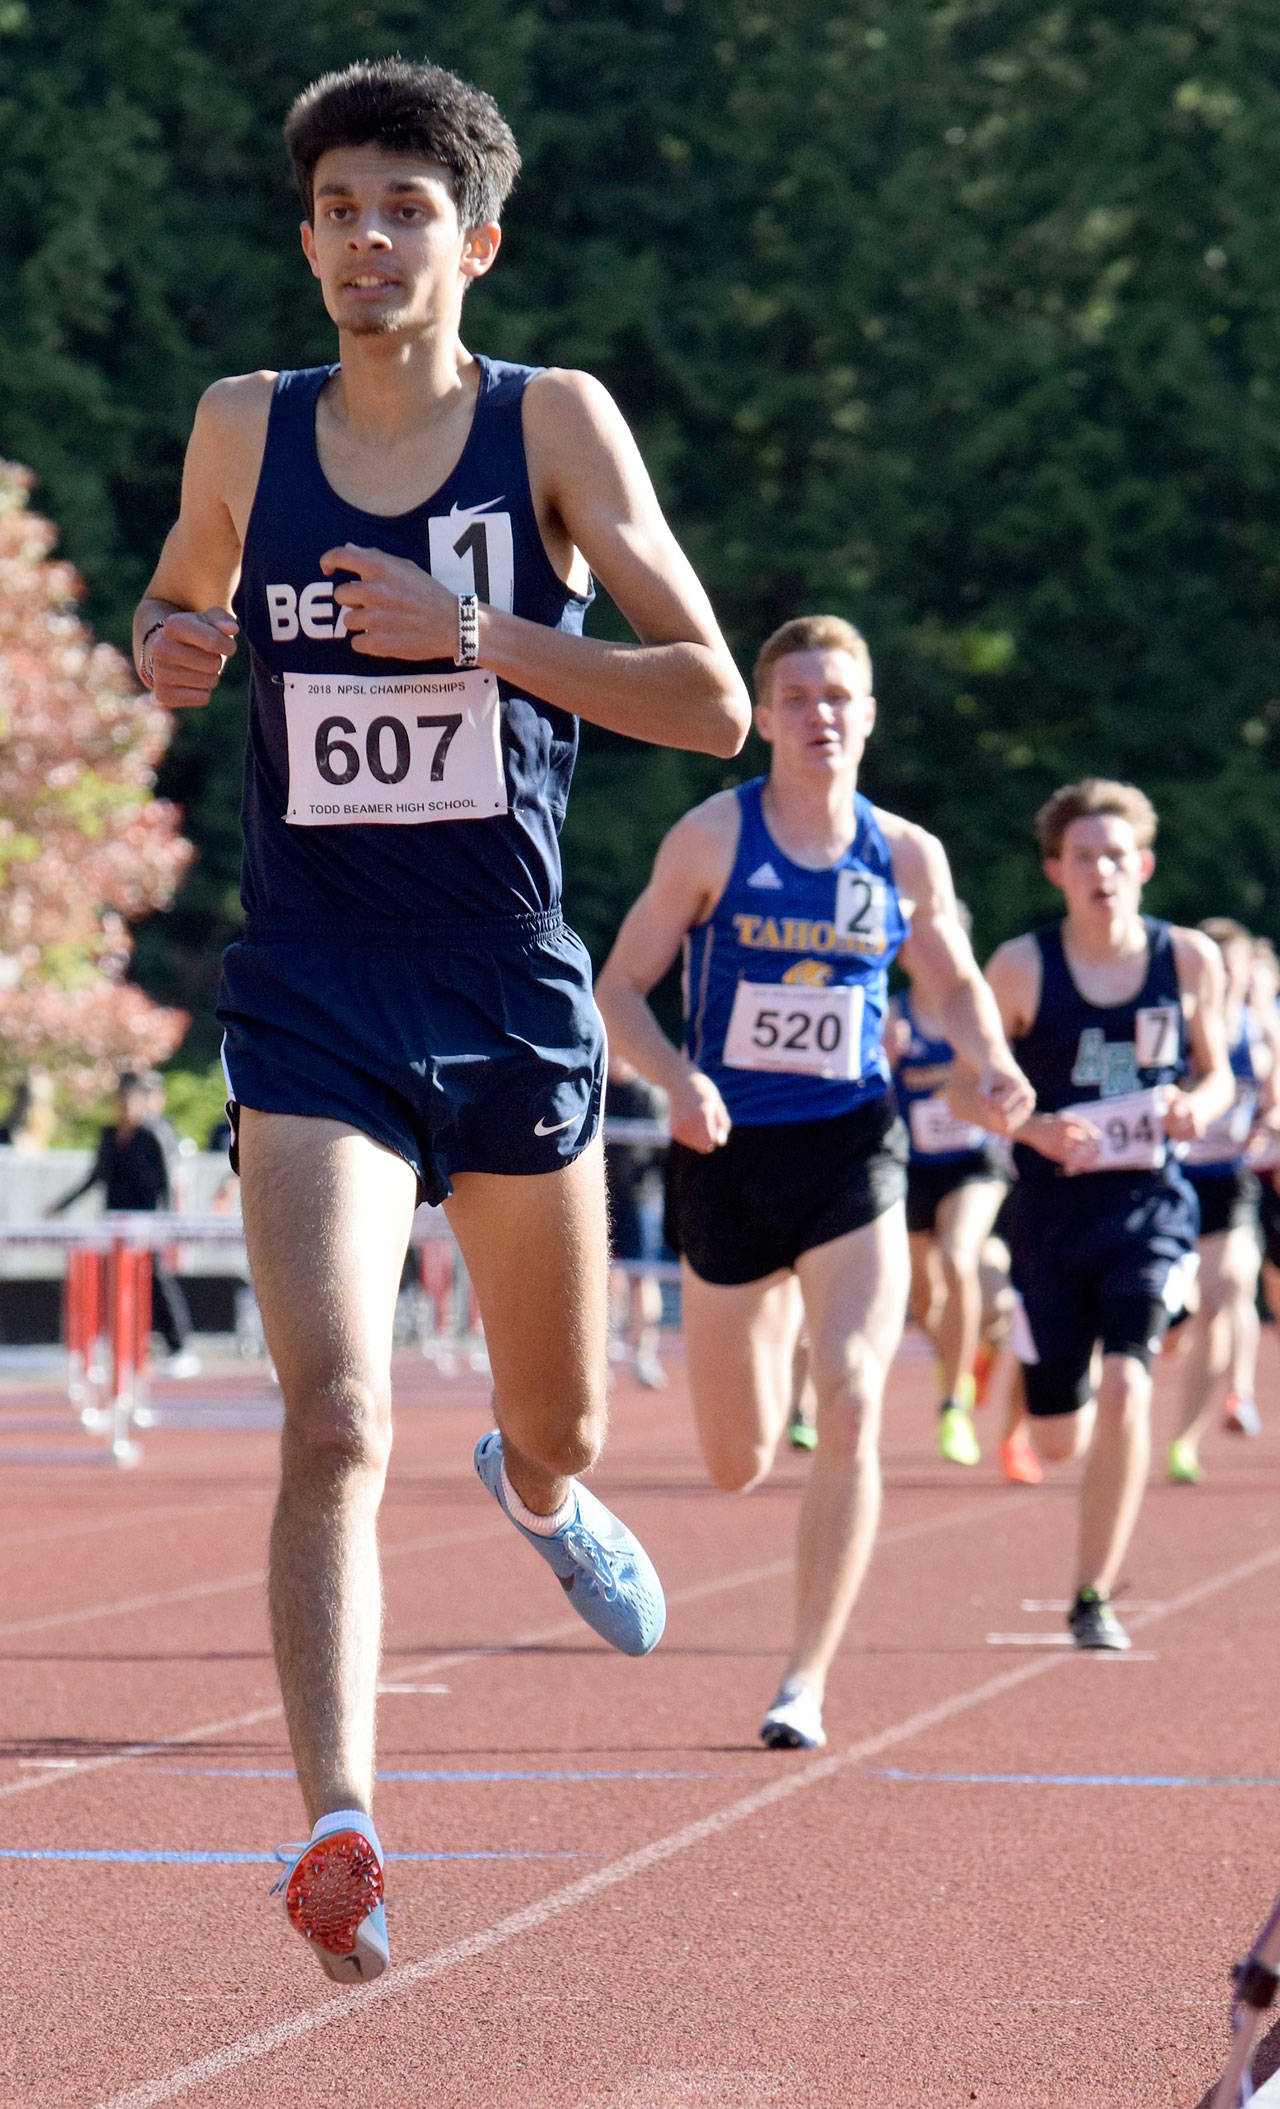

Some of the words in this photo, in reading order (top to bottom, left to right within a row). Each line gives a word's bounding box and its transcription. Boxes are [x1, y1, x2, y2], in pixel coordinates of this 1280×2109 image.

[453, 521, 490, 605] 1
[308, 685, 332, 695] 2018
[337, 684, 367, 695] NPSL
[369, 681, 467, 695] CHAMPIONSHIPS
[314, 713, 464, 786] 607
[309, 804, 341, 815] TODD
[343, 803, 394, 815] BEAMER
[396, 801, 426, 813] HIGH
[428, 798, 479, 812] SCHOOL
[848, 878, 873, 934] 2
[733, 912, 887, 957] TAHO
[752, 1009, 842, 1052] 520
[1149, 1015, 1169, 1060] 7
